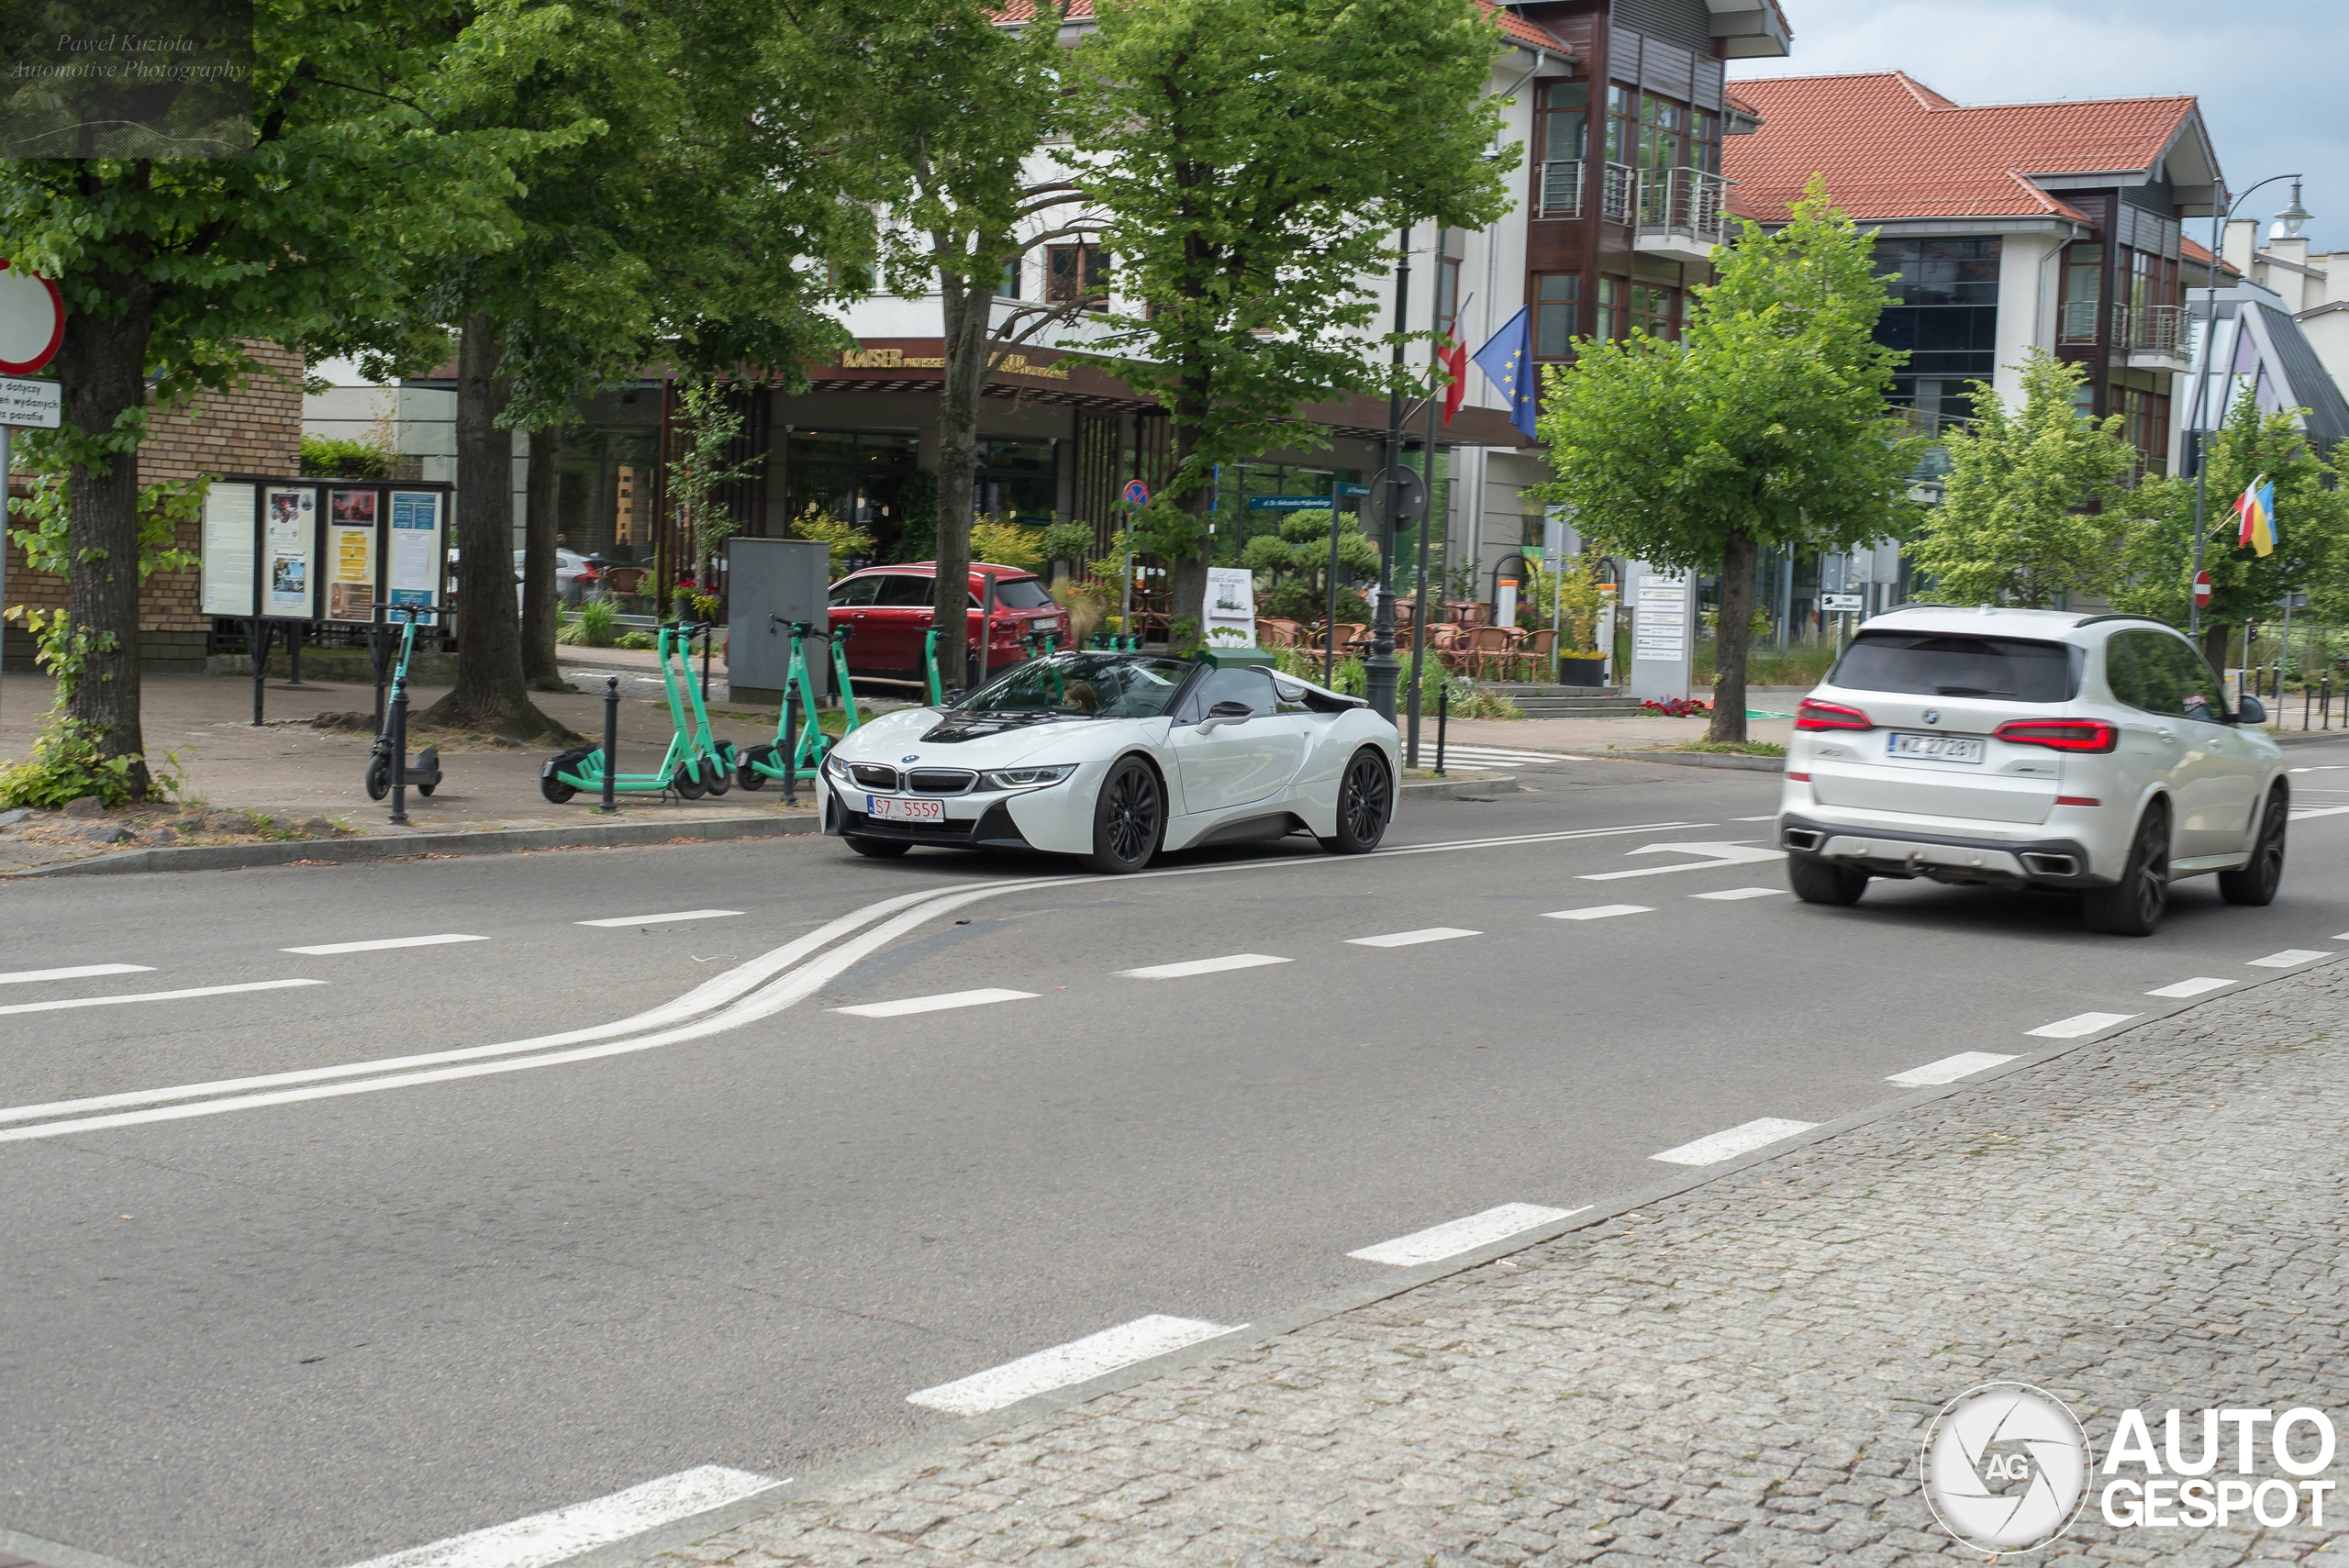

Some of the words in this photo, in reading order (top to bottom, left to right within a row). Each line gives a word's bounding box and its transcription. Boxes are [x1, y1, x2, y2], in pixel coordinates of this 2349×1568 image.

[842, 349, 903, 368] KAISER
[6, 382, 41, 396] dotyczy
[13, 397, 59, 411] wydanych
[875, 799, 891, 815] S7
[904, 801, 940, 817] 5559
